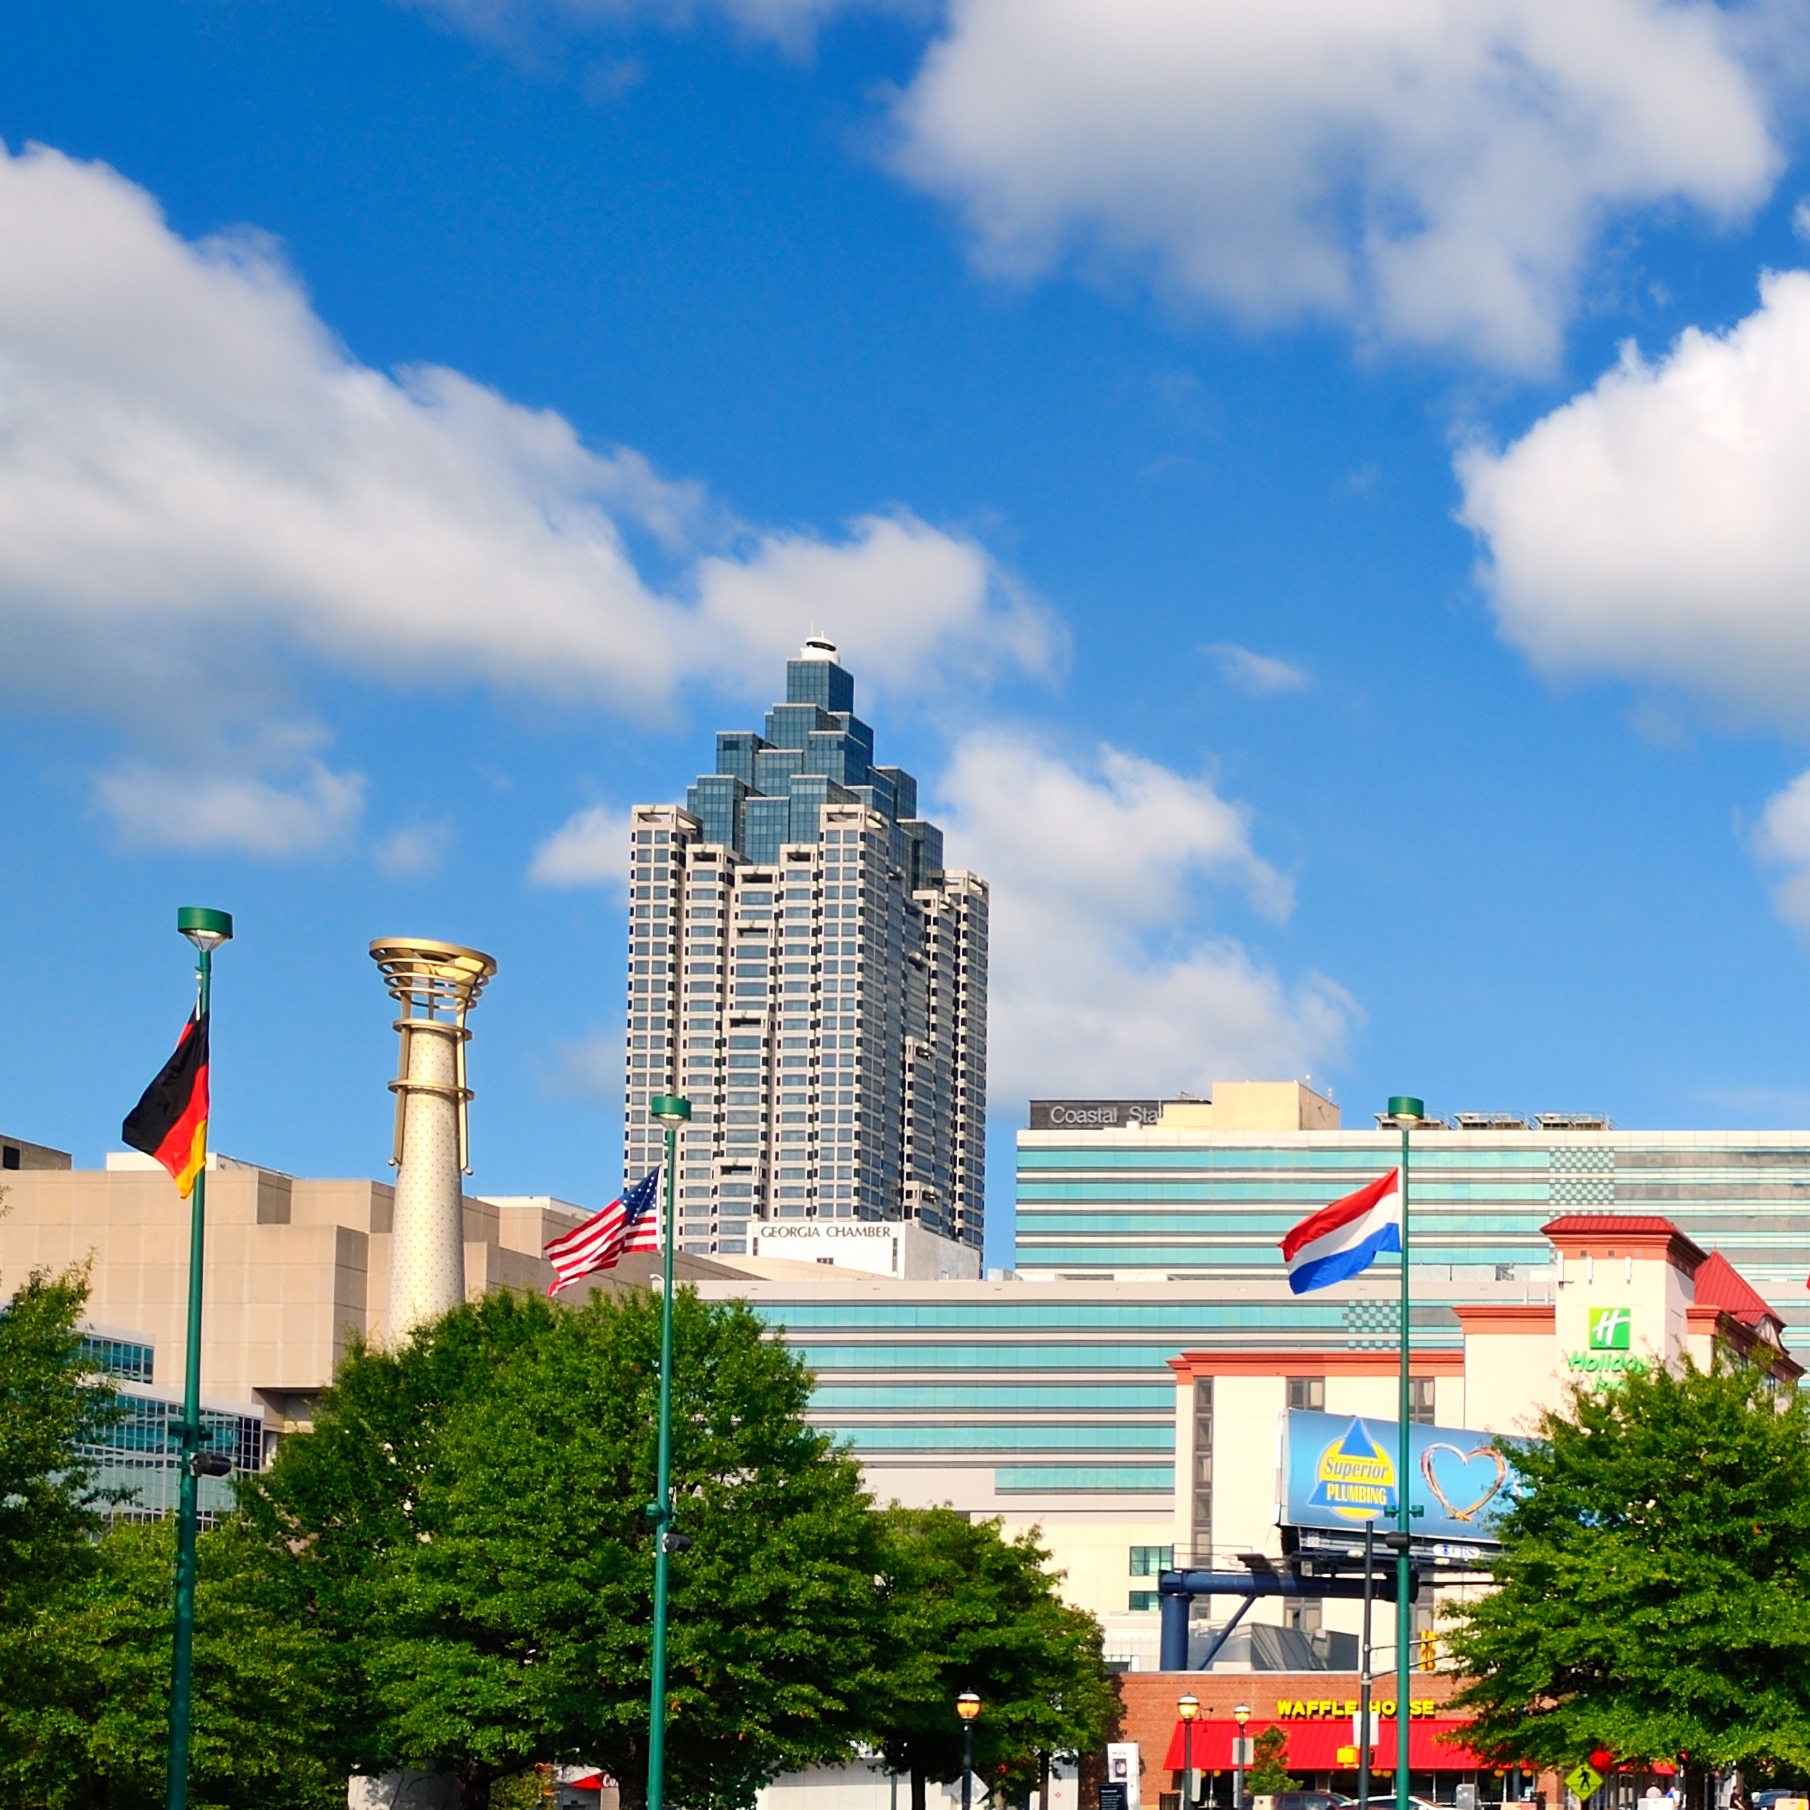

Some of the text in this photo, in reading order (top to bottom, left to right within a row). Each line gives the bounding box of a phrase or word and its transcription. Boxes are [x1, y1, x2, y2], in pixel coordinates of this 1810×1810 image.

[1050, 1106, 1117, 1124] Coastal
[761, 1226, 891, 1238] GEORGIA CHAMBER
[1568, 1350, 1650, 1377] Holiday
[1324, 1457, 1389, 1480] Superior
[1326, 1483, 1387, 1505] PLUMBING
[1277, 1700, 1435, 1716] WAFFLE HOSE
